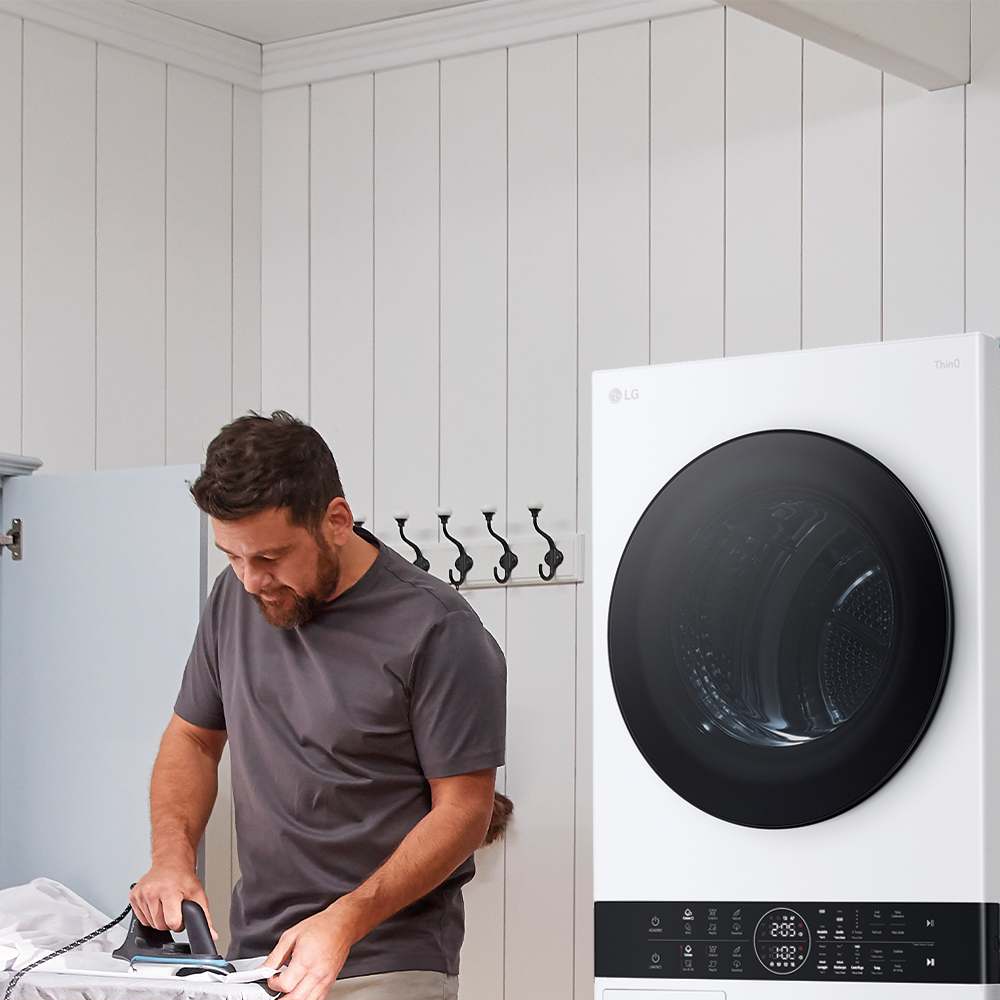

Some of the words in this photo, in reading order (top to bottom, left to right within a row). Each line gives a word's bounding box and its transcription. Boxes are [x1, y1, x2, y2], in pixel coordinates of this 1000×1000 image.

[934, 358, 961, 369] ThinQ
[624, 388, 640, 401] LG
[770, 922, 796, 937] 2:05
[775, 945, 796, 960] 1:02
